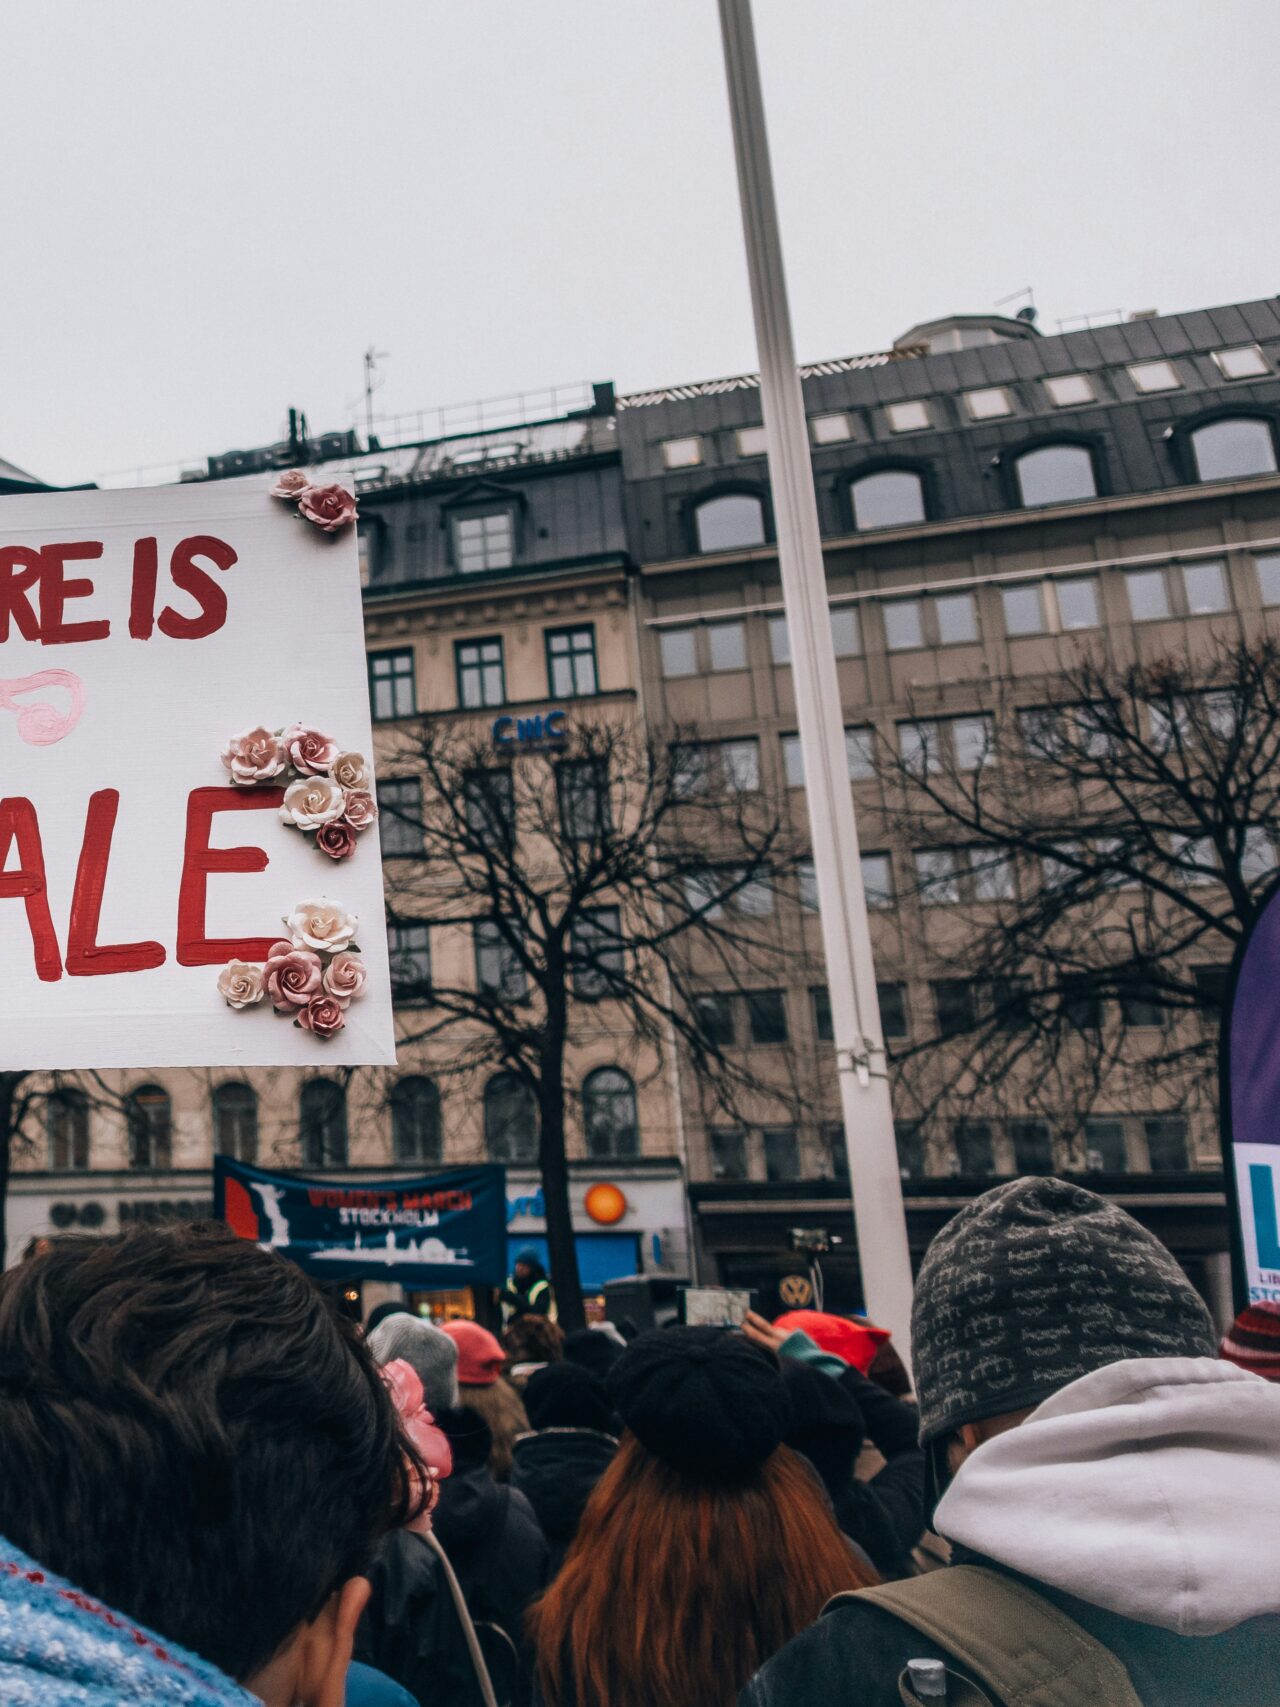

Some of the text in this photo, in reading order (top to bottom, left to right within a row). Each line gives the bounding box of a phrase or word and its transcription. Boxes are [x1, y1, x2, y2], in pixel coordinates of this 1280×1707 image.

[129, 535, 238, 640] IS
[402, 1190, 473, 1211] MARCH
[339, 1206, 440, 1228] STOCKHOLM
